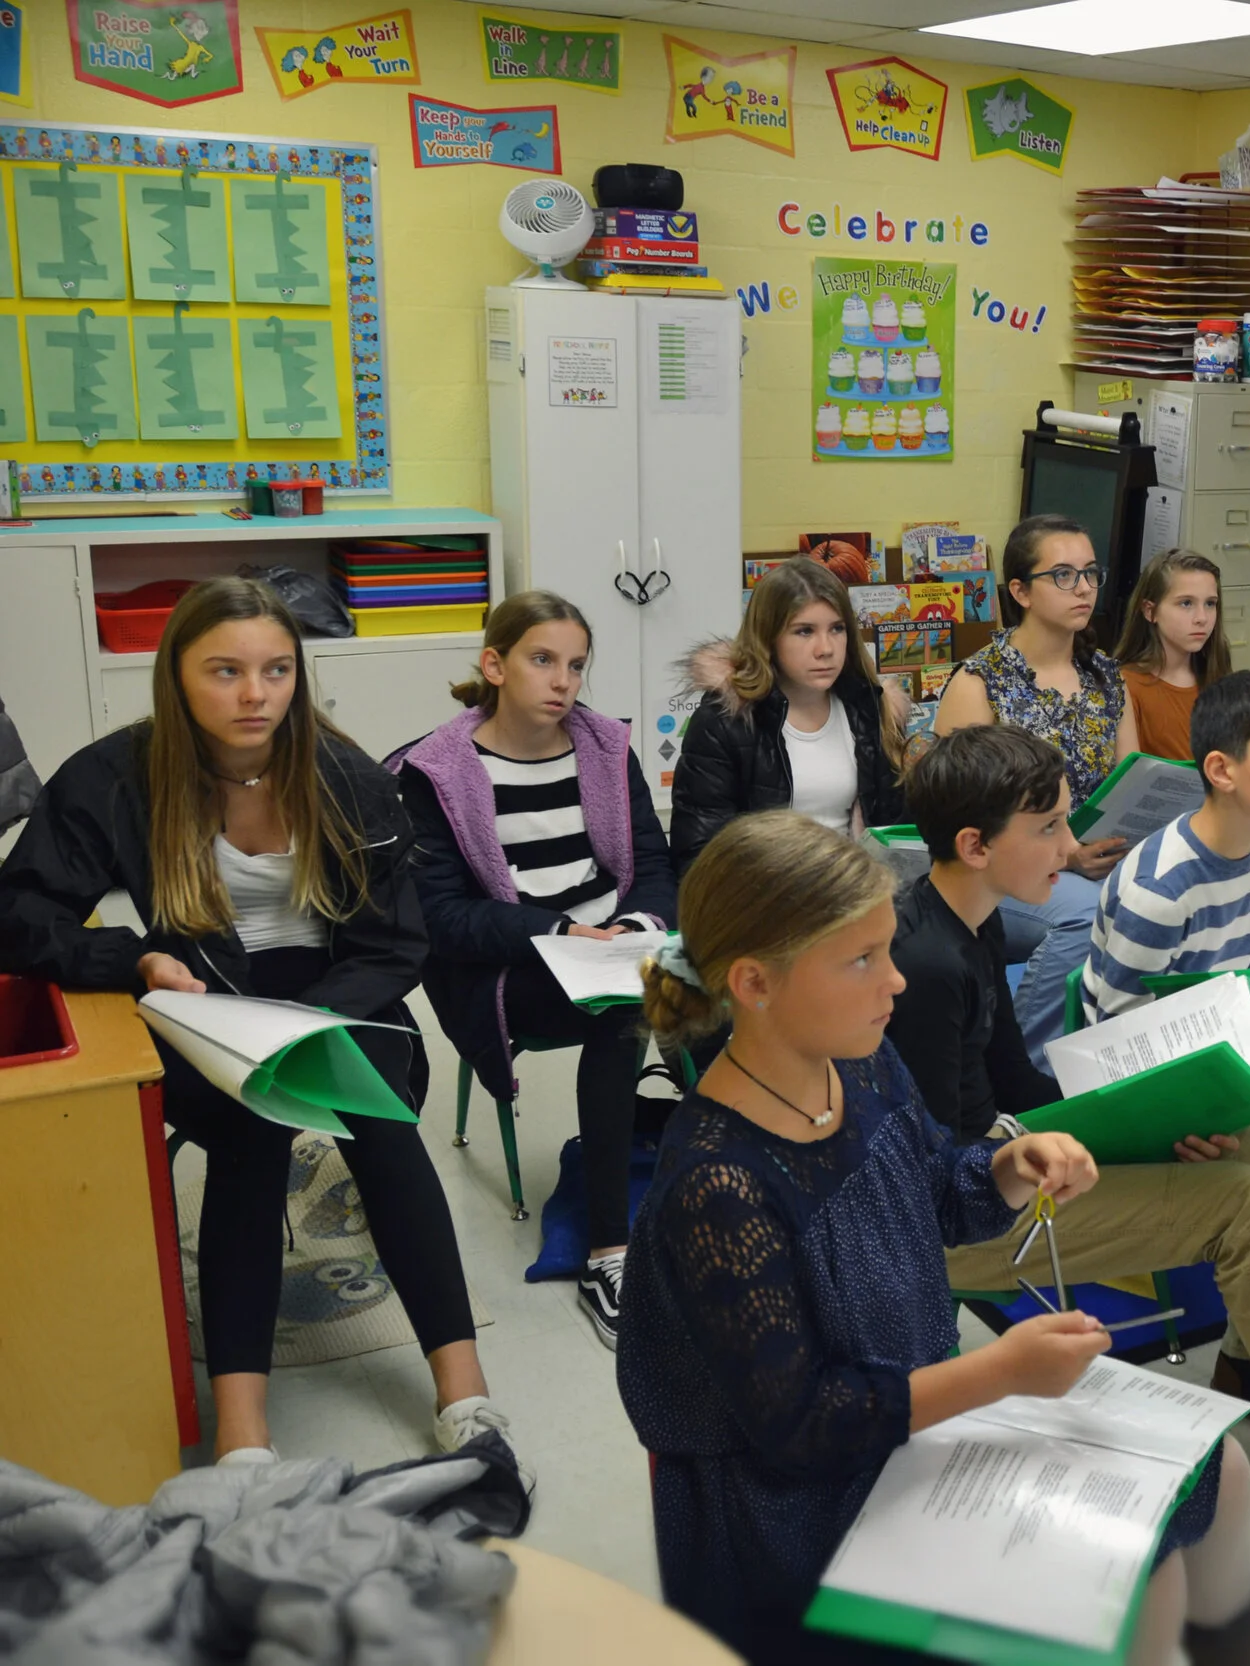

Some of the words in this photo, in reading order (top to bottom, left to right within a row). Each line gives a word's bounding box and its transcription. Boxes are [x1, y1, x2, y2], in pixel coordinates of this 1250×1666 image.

[94, 12, 151, 36] Raise
[357, 24, 400, 44] Wait
[106, 35, 141, 50] Your
[488, 26, 526, 46] Walk
[90, 45, 153, 71] Hand
[345, 44, 378, 59] Your
[500, 44, 512, 57] in
[370, 57, 411, 75] Turn
[492, 57, 528, 77] Line
[747, 89, 766, 105] Be
[771, 95, 778, 105] a
[419, 108, 460, 130] Keep
[462, 114, 486, 129] your
[739, 108, 787, 127] Friend
[434, 130, 466, 143] Hands
[467, 131, 480, 141] to
[855, 119, 879, 136] Help
[880, 126, 916, 144] Clean
[423, 139, 493, 162] Yourself
[1019, 130, 1061, 154] Listen
[778, 203, 989, 246] Celebrate
[627, 247, 639, 256] Peg
[671, 250, 693, 258] Boards
[818, 268, 870, 296] Happy
[875, 264, 951, 305] Birthday!
[737, 281, 799, 317] We
[971, 287, 1047, 333] You!
